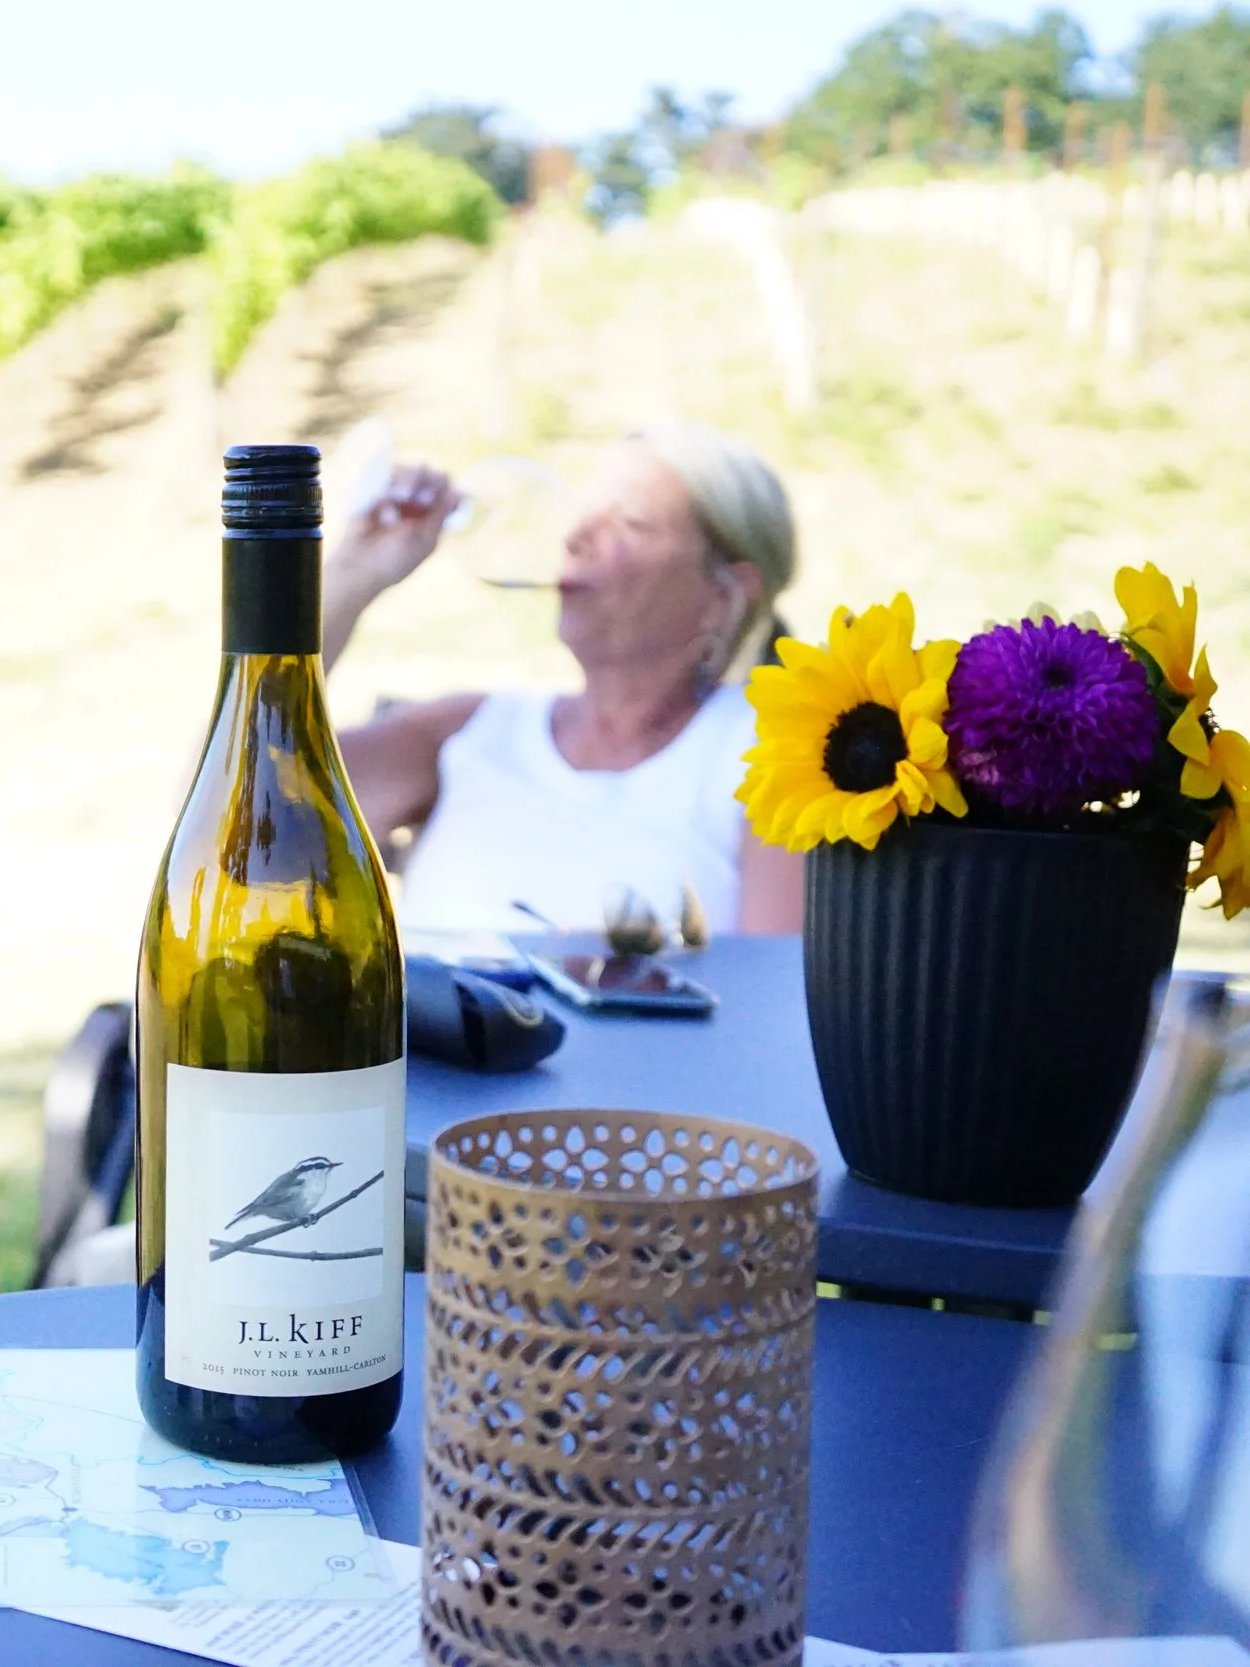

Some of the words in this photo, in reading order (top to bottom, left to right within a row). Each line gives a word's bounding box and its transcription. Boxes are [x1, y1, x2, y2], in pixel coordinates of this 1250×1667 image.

[238, 1321, 280, 1345] J.L.
[253, 1345, 352, 1359] VINEYARD
[202, 1363, 225, 1375] 2015
[232, 1367, 267, 1377] PINOT
[270, 1369, 300, 1378] NOIR
[306, 1353, 387, 1377] YAMHILL-CARLTON
